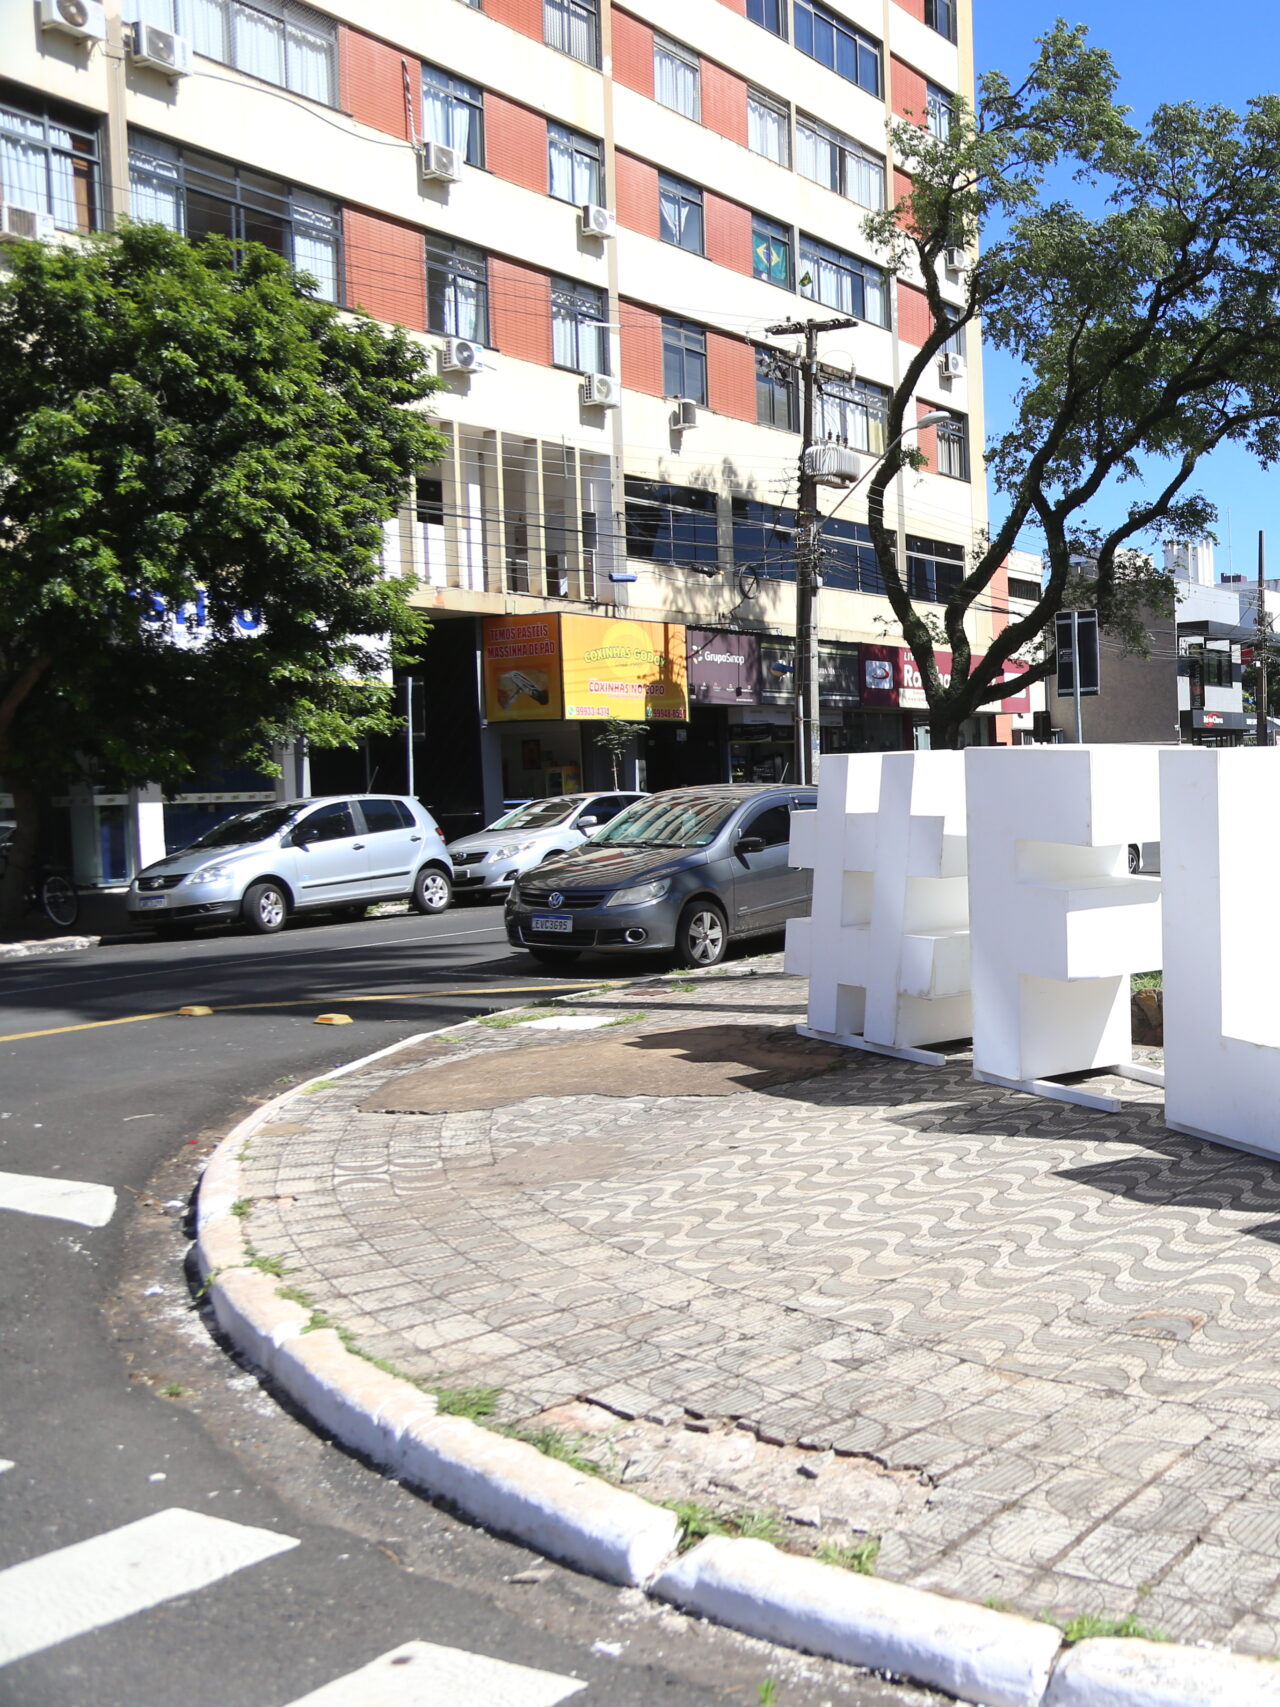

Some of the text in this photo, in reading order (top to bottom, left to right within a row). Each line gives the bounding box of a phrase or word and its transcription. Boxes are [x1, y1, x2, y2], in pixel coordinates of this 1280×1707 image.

[488, 626, 516, 643] TEMOS
[487, 638, 555, 660] MASSINHA DE PÃO
[584, 645, 632, 664] COXINHAS
[588, 680, 666, 696] COXINHAS NO COPO
